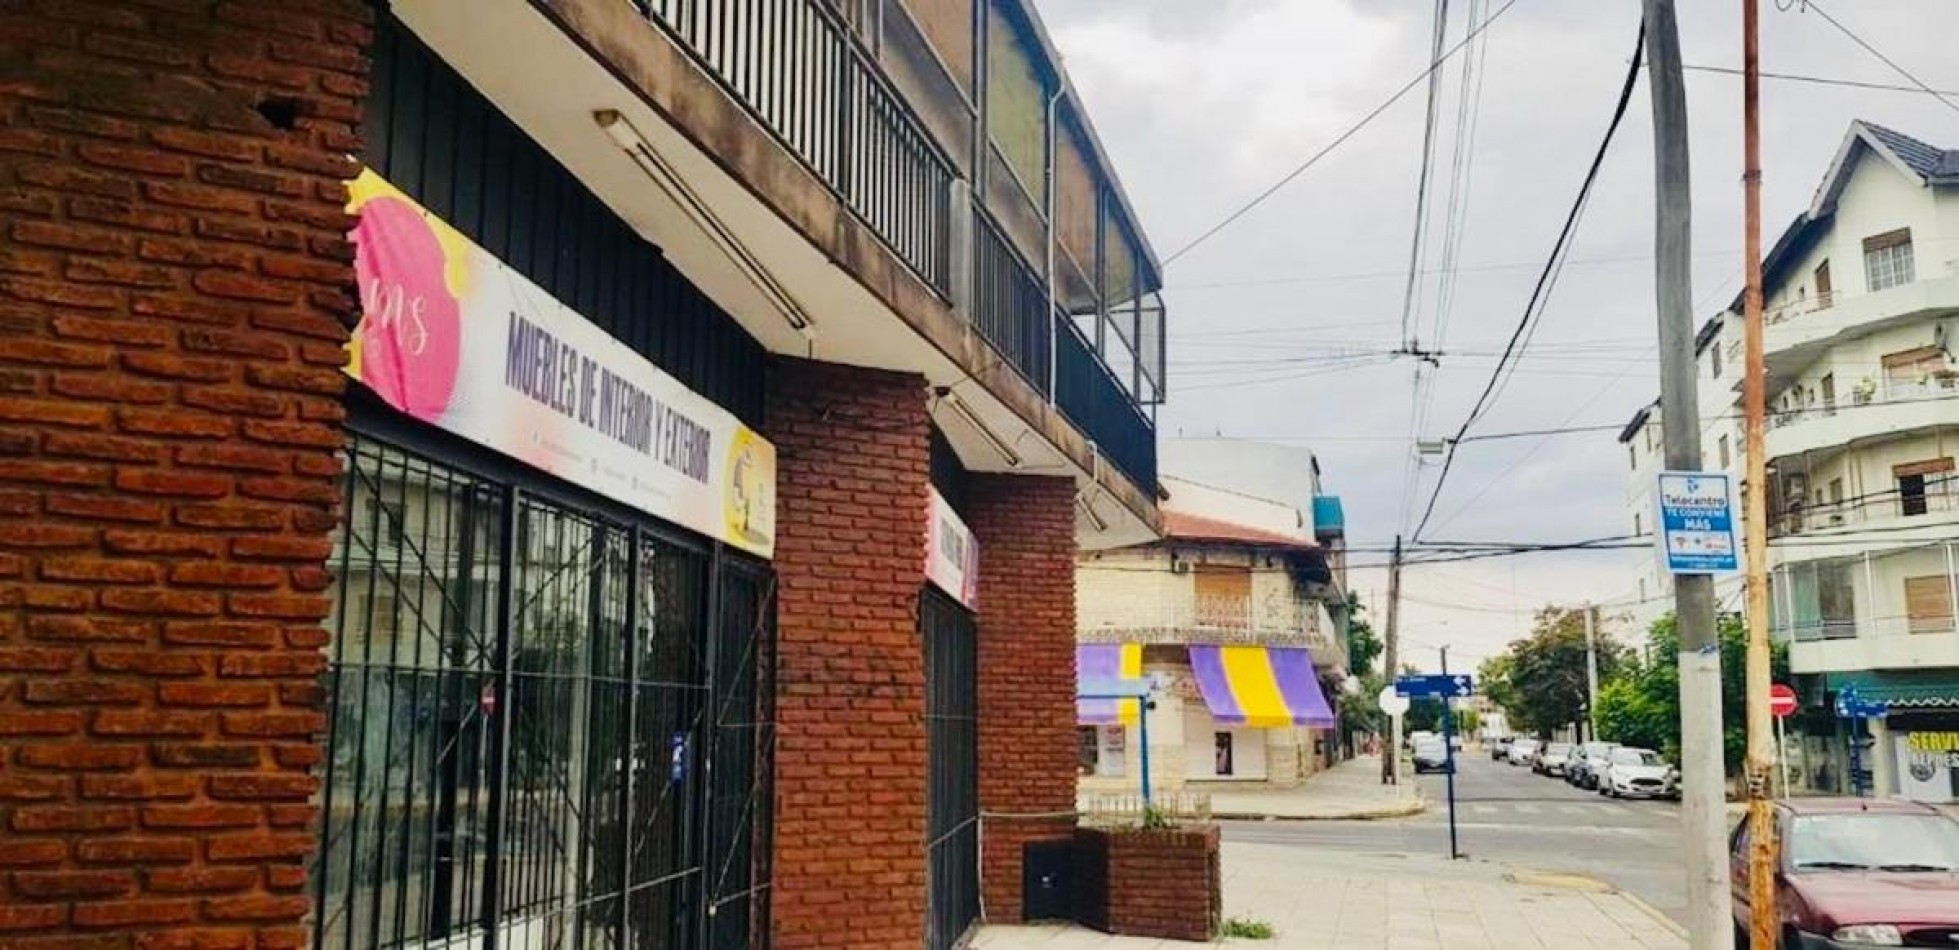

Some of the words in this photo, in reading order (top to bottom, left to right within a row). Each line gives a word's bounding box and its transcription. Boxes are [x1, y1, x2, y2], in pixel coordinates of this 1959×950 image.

[506, 311, 578, 419] MUEBLES
[579, 355, 599, 429] DE
[599, 366, 654, 456] INTERIOR
[654, 398, 665, 462] Y
[664, 406, 711, 485] EXTERIOR
[1665, 494, 1726, 505] Telecentro
[1667, 508, 1678, 517] TE
